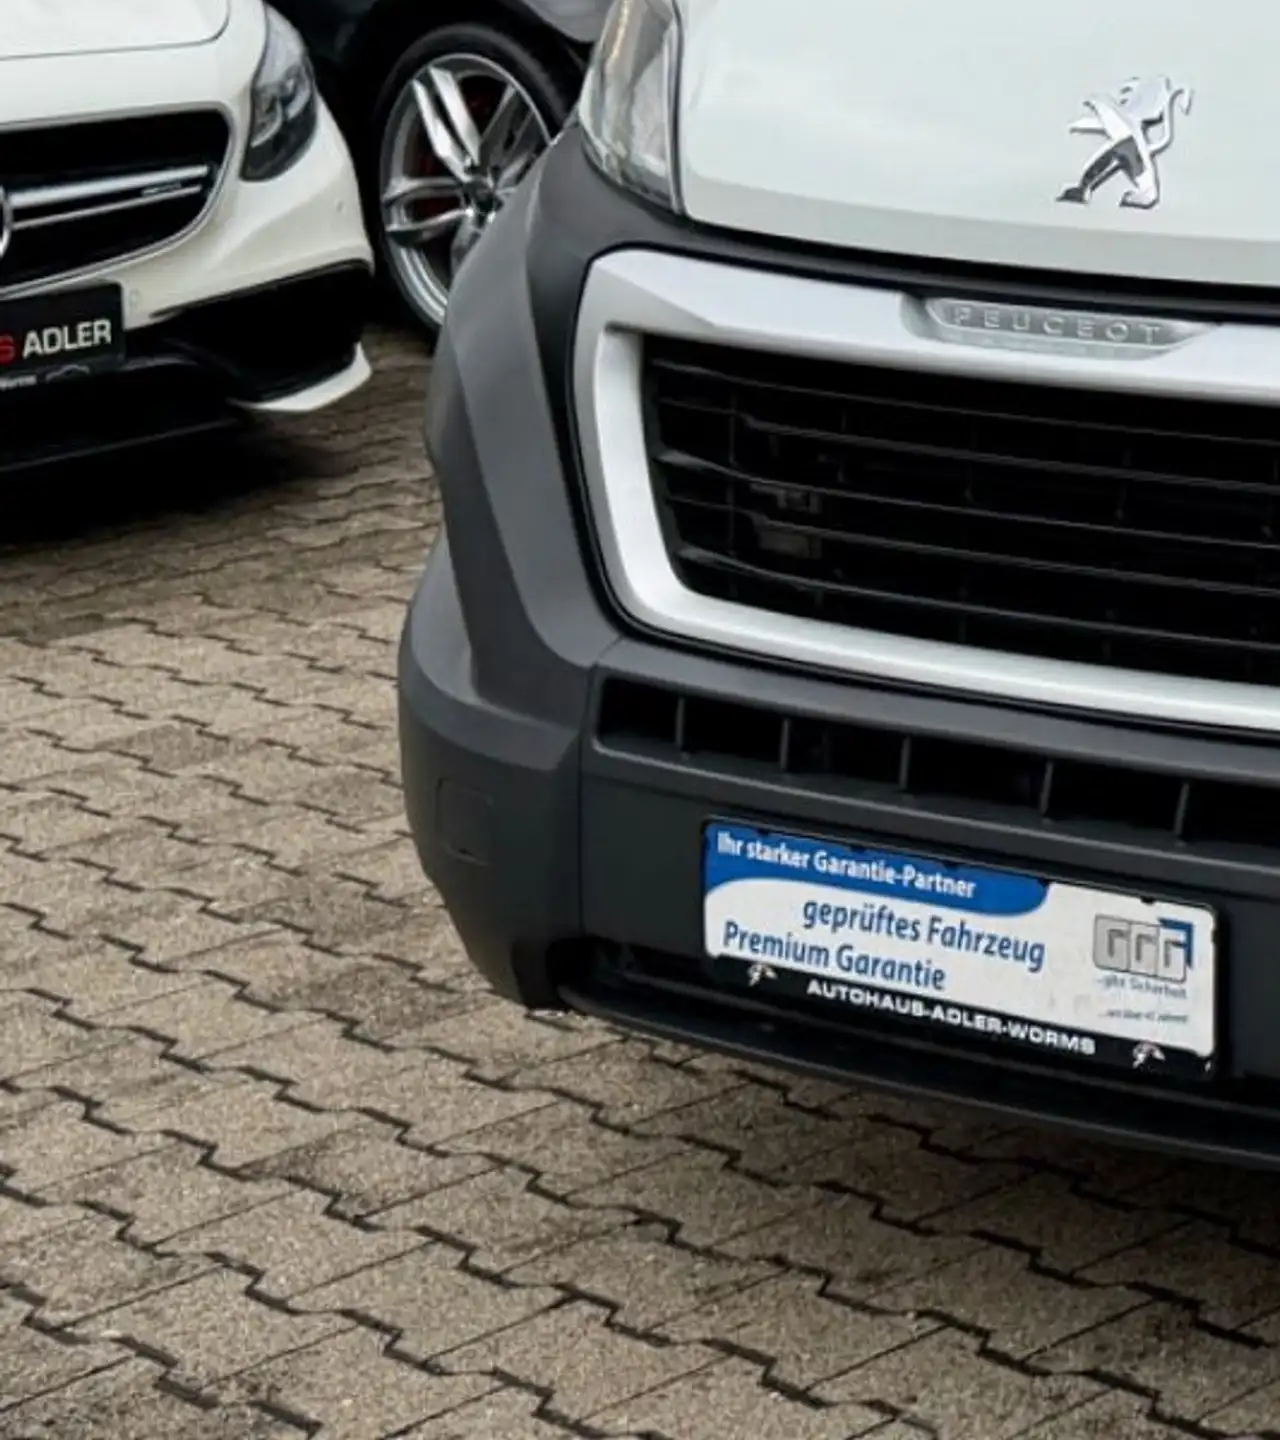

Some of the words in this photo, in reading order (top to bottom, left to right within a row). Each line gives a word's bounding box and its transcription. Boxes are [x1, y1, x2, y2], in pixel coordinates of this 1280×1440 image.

[22, 318, 112, 360] ADLER
[954, 306, 1162, 344] PEUGEOT
[717, 830, 743, 857] Ihr
[746, 840, 811, 870] starker
[813, 850, 977, 899] Garantie-Partner
[723, 920, 829, 969] Premium
[836, 944, 946, 992] Garantie
[802, 900, 921, 943] geprüftes
[926, 915, 1046, 974] Fahrzeug
